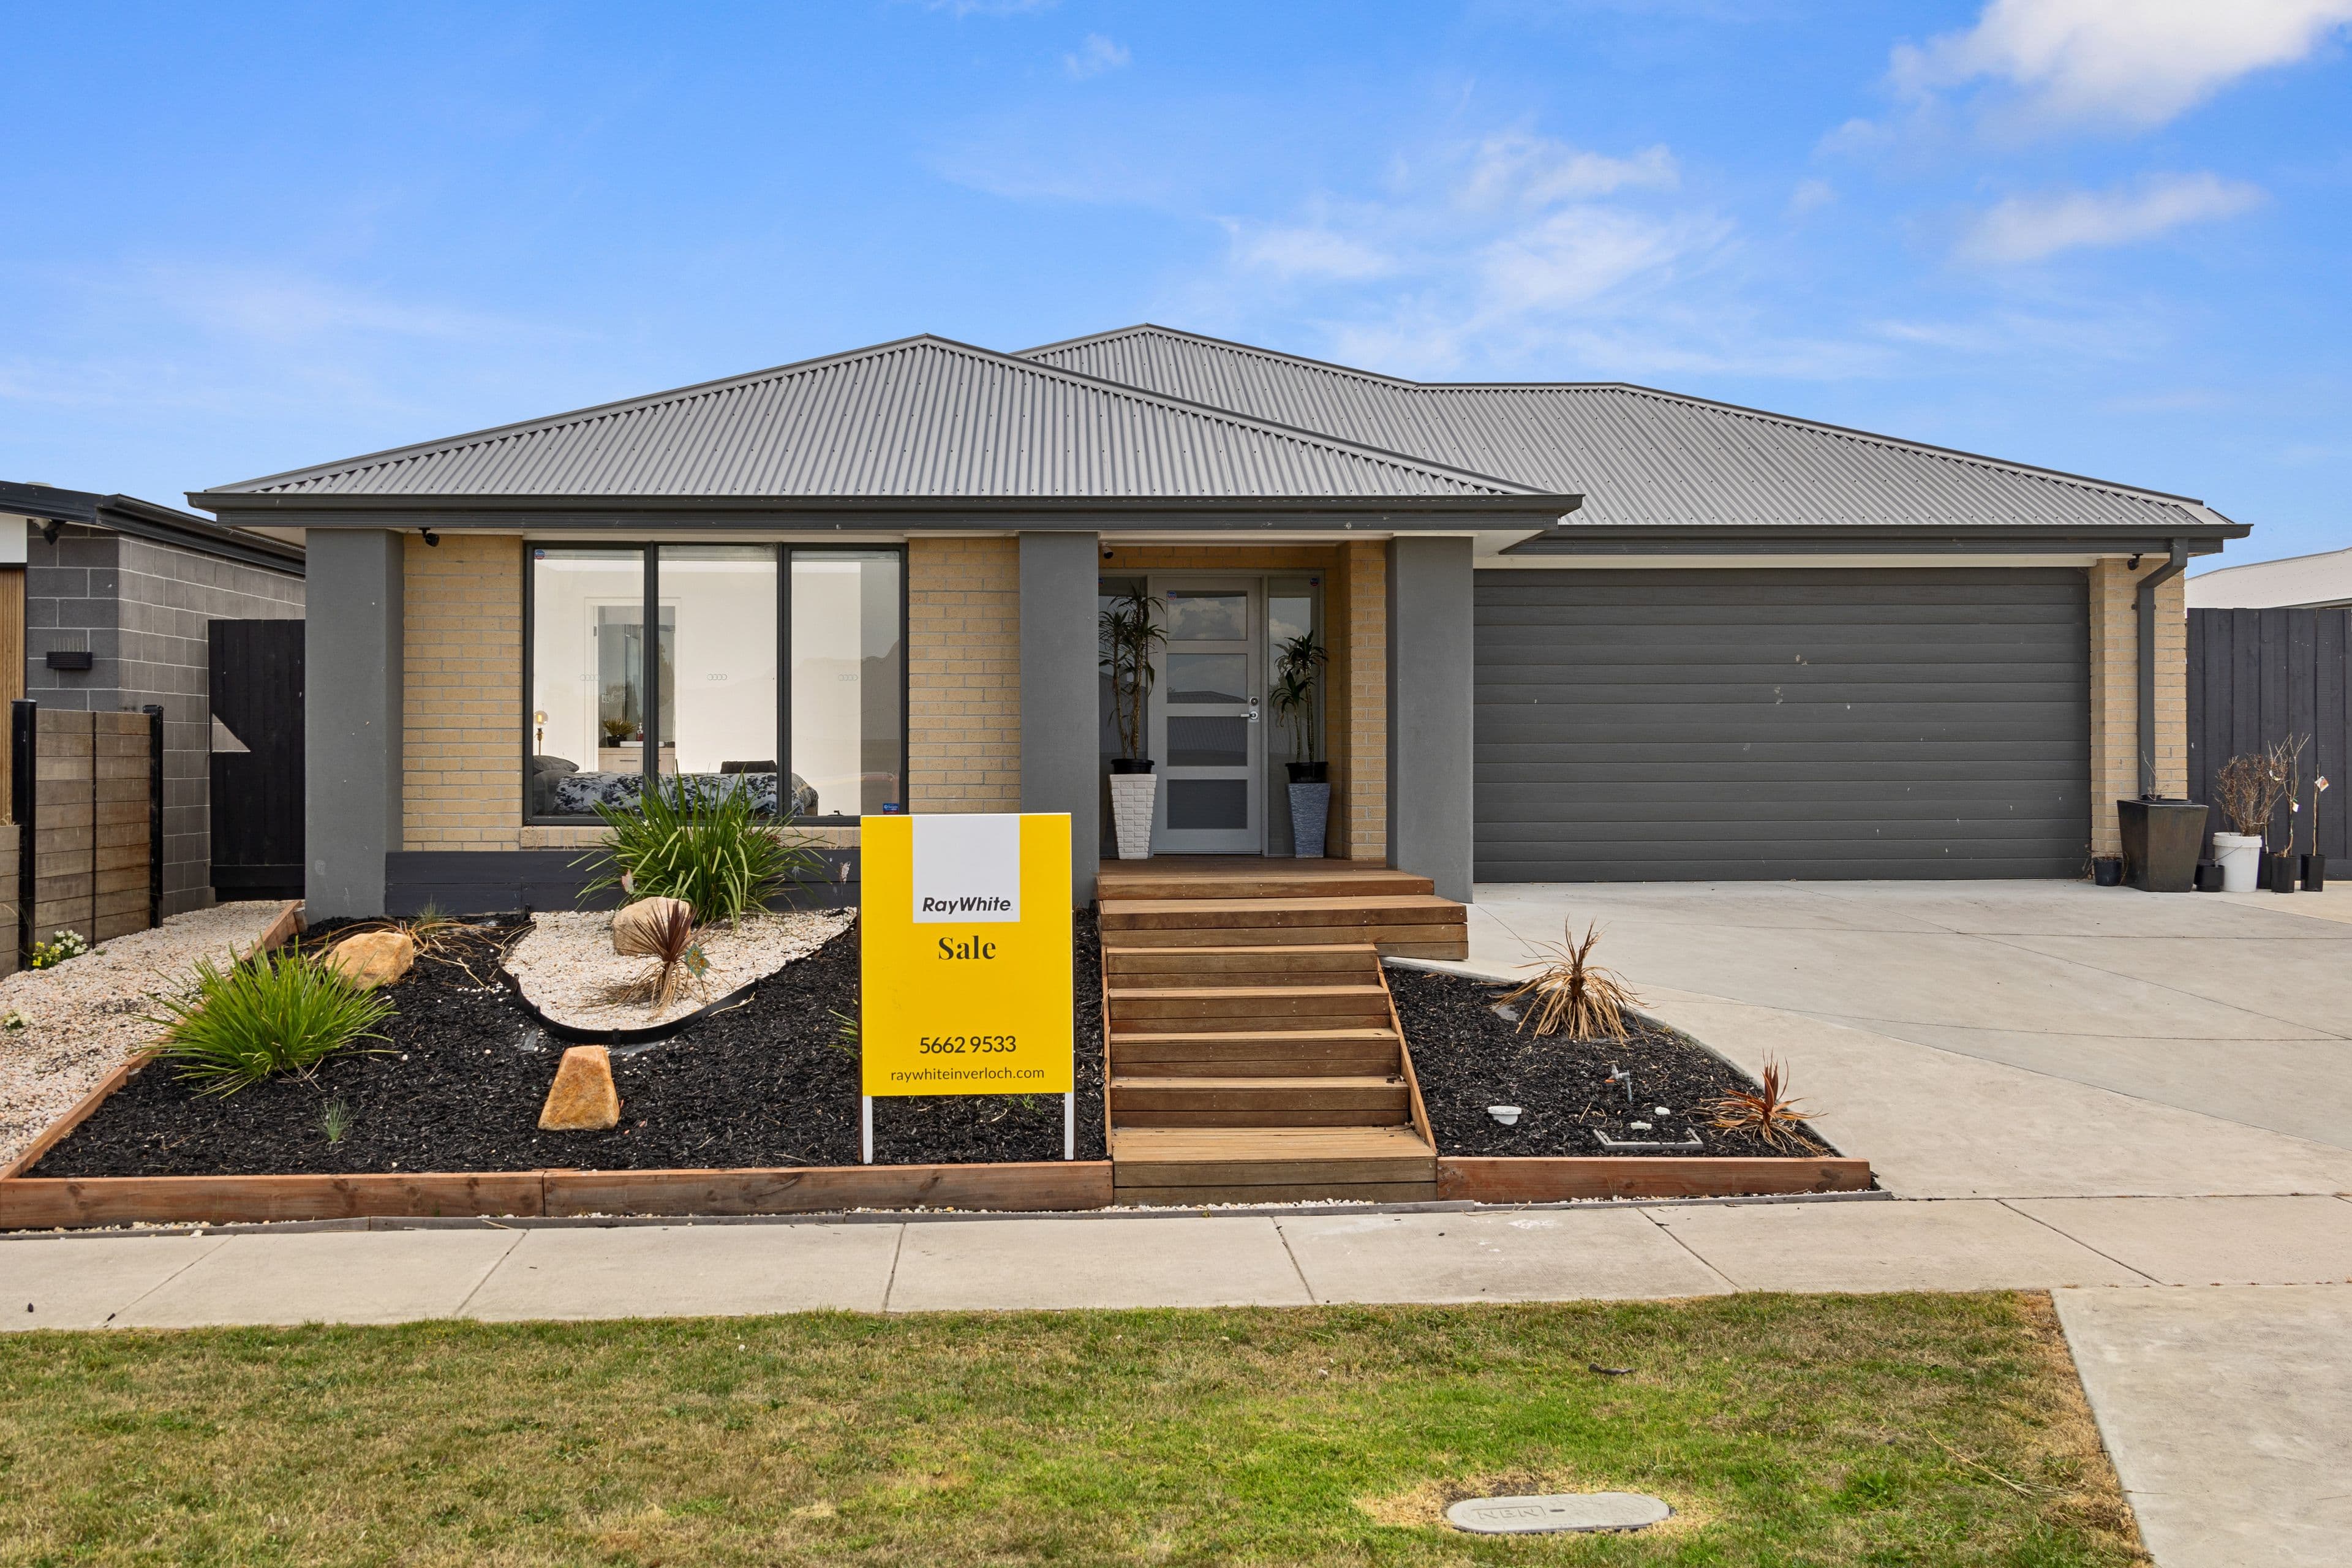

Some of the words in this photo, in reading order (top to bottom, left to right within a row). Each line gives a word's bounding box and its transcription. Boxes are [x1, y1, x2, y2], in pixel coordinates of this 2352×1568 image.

[938, 935, 996, 960] Sale
[919, 1036, 966, 1054] 5662
[970, 1036, 1016, 1053] 9533
[891, 1067, 1044, 1083] raywhiteinverloch.com
